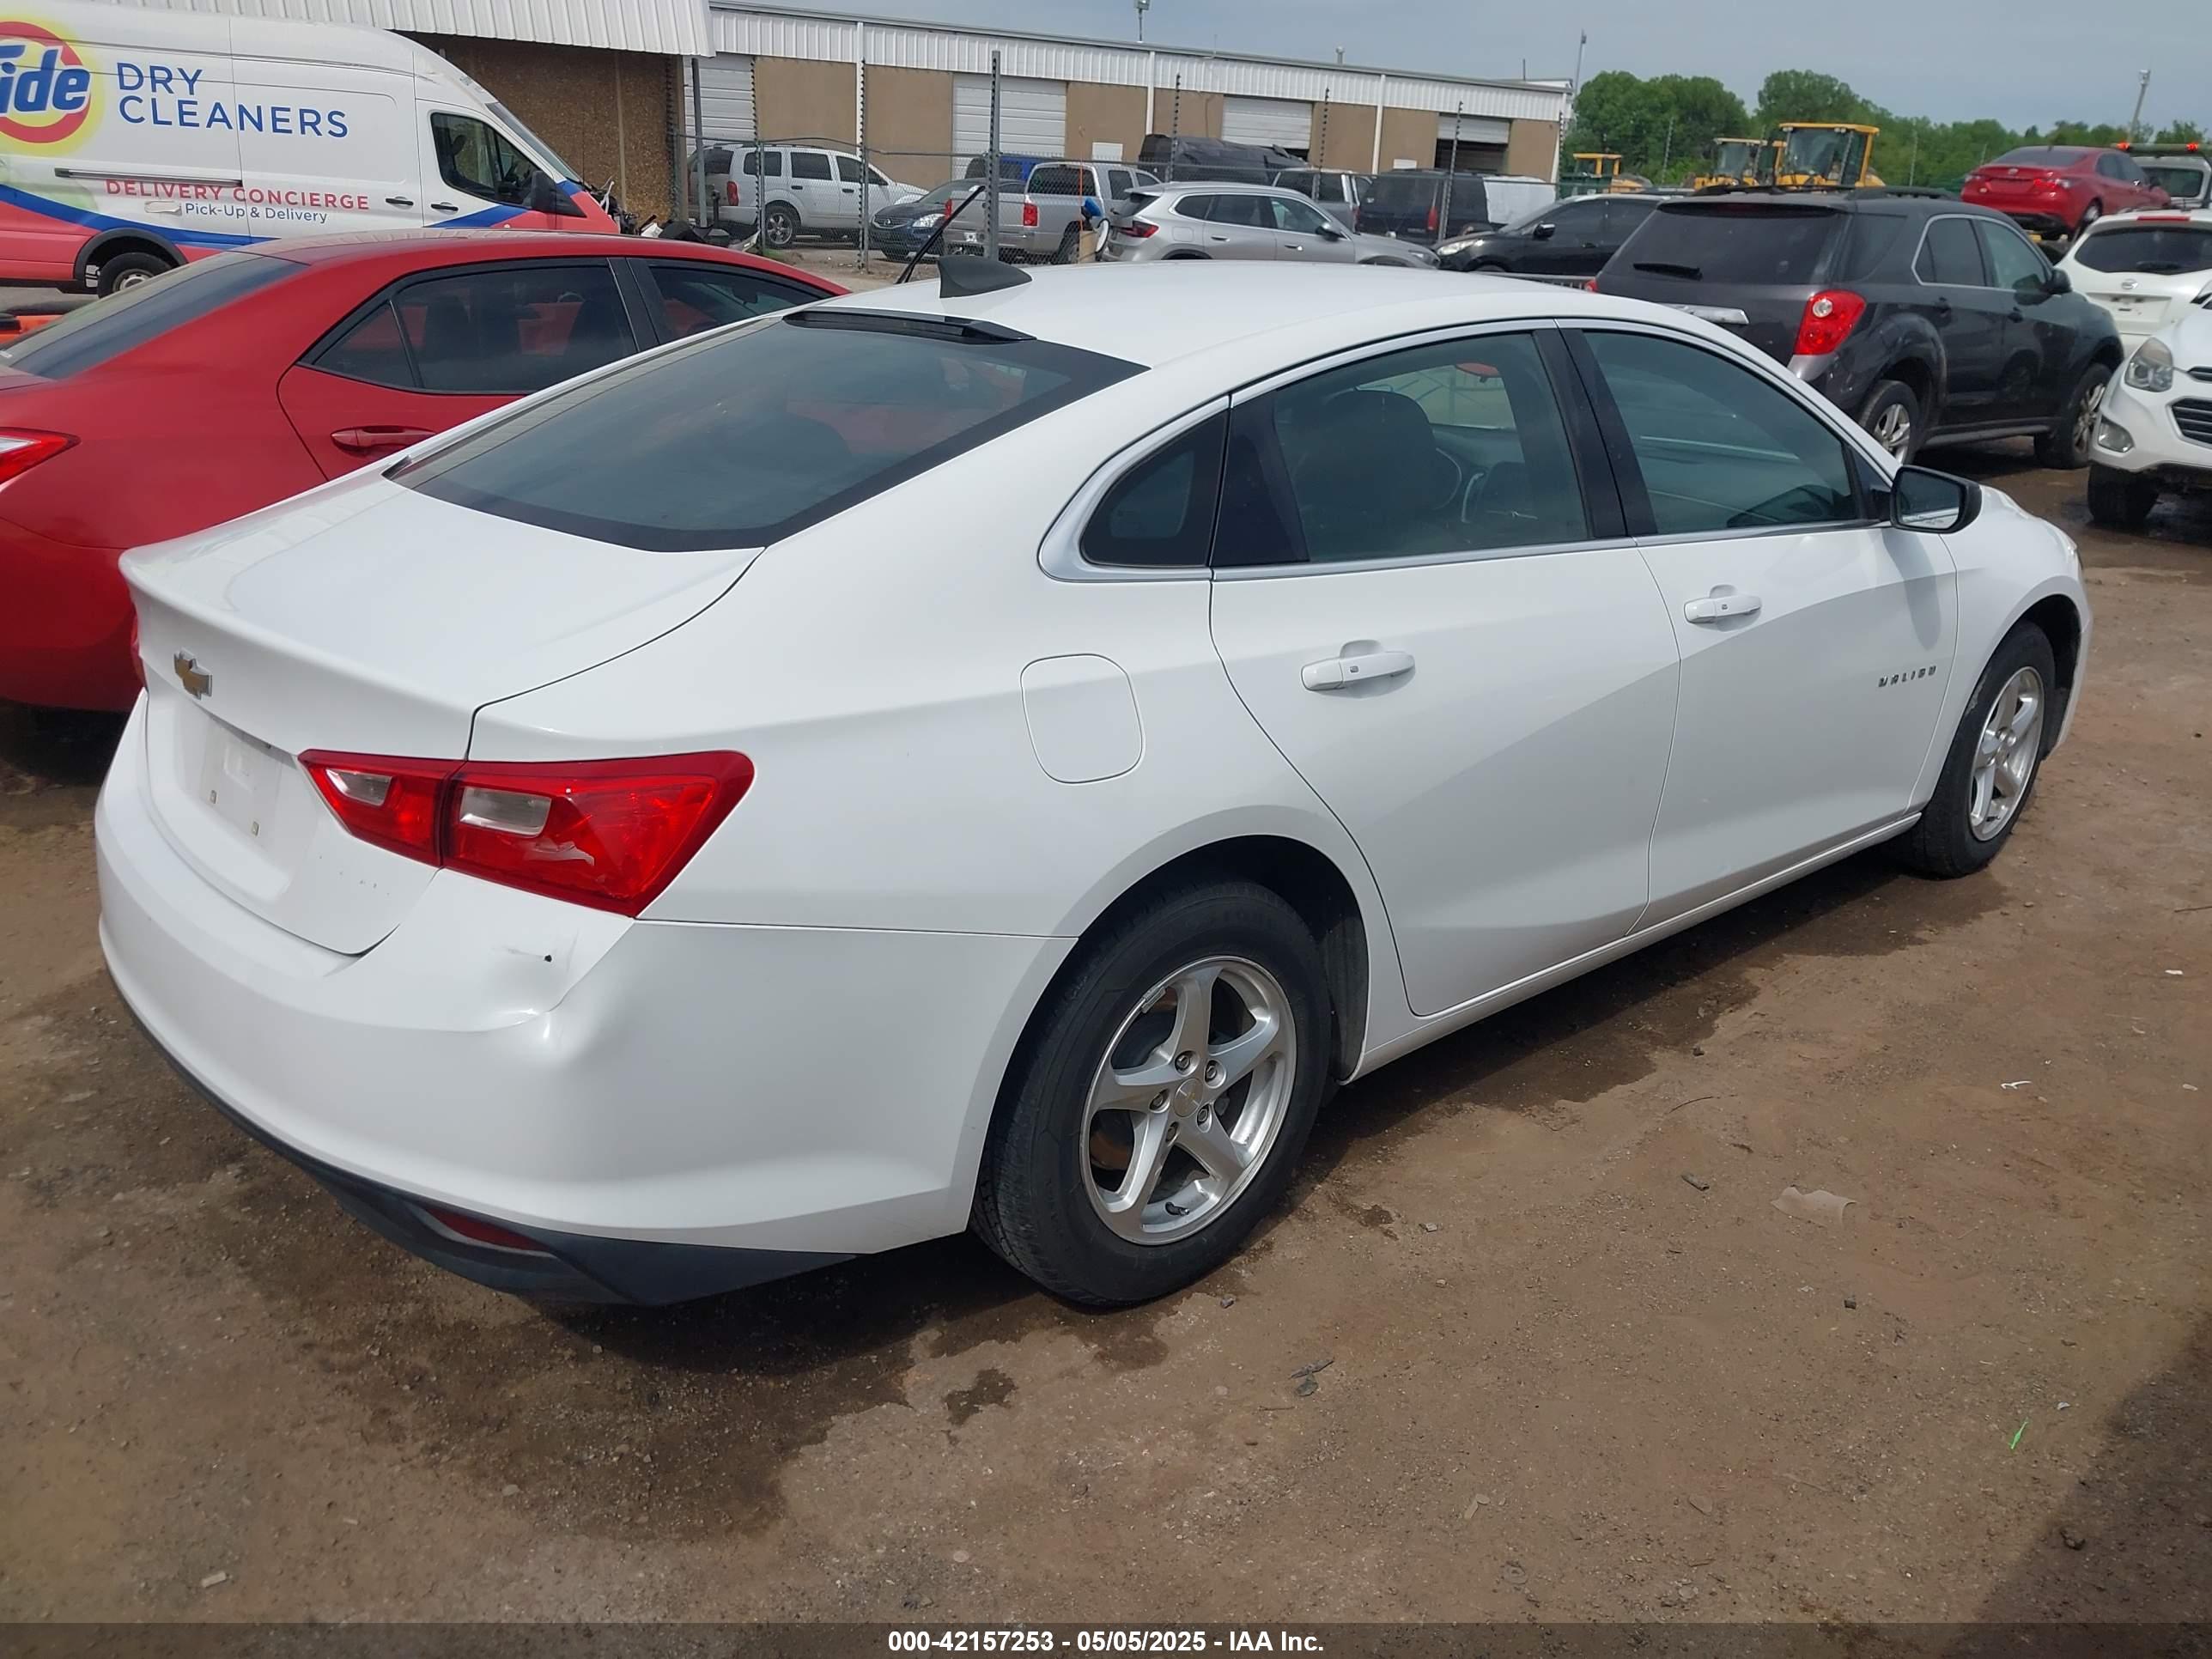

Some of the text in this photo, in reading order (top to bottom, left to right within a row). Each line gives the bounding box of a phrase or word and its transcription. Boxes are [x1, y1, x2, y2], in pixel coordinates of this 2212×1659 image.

[117, 62, 203, 95] DRY
[119, 95, 349, 138] CLEANERS
[106, 179, 370, 210] DELIVERY CONCIERGE
[185, 203, 328, 223] Pick-Up & Delivery
